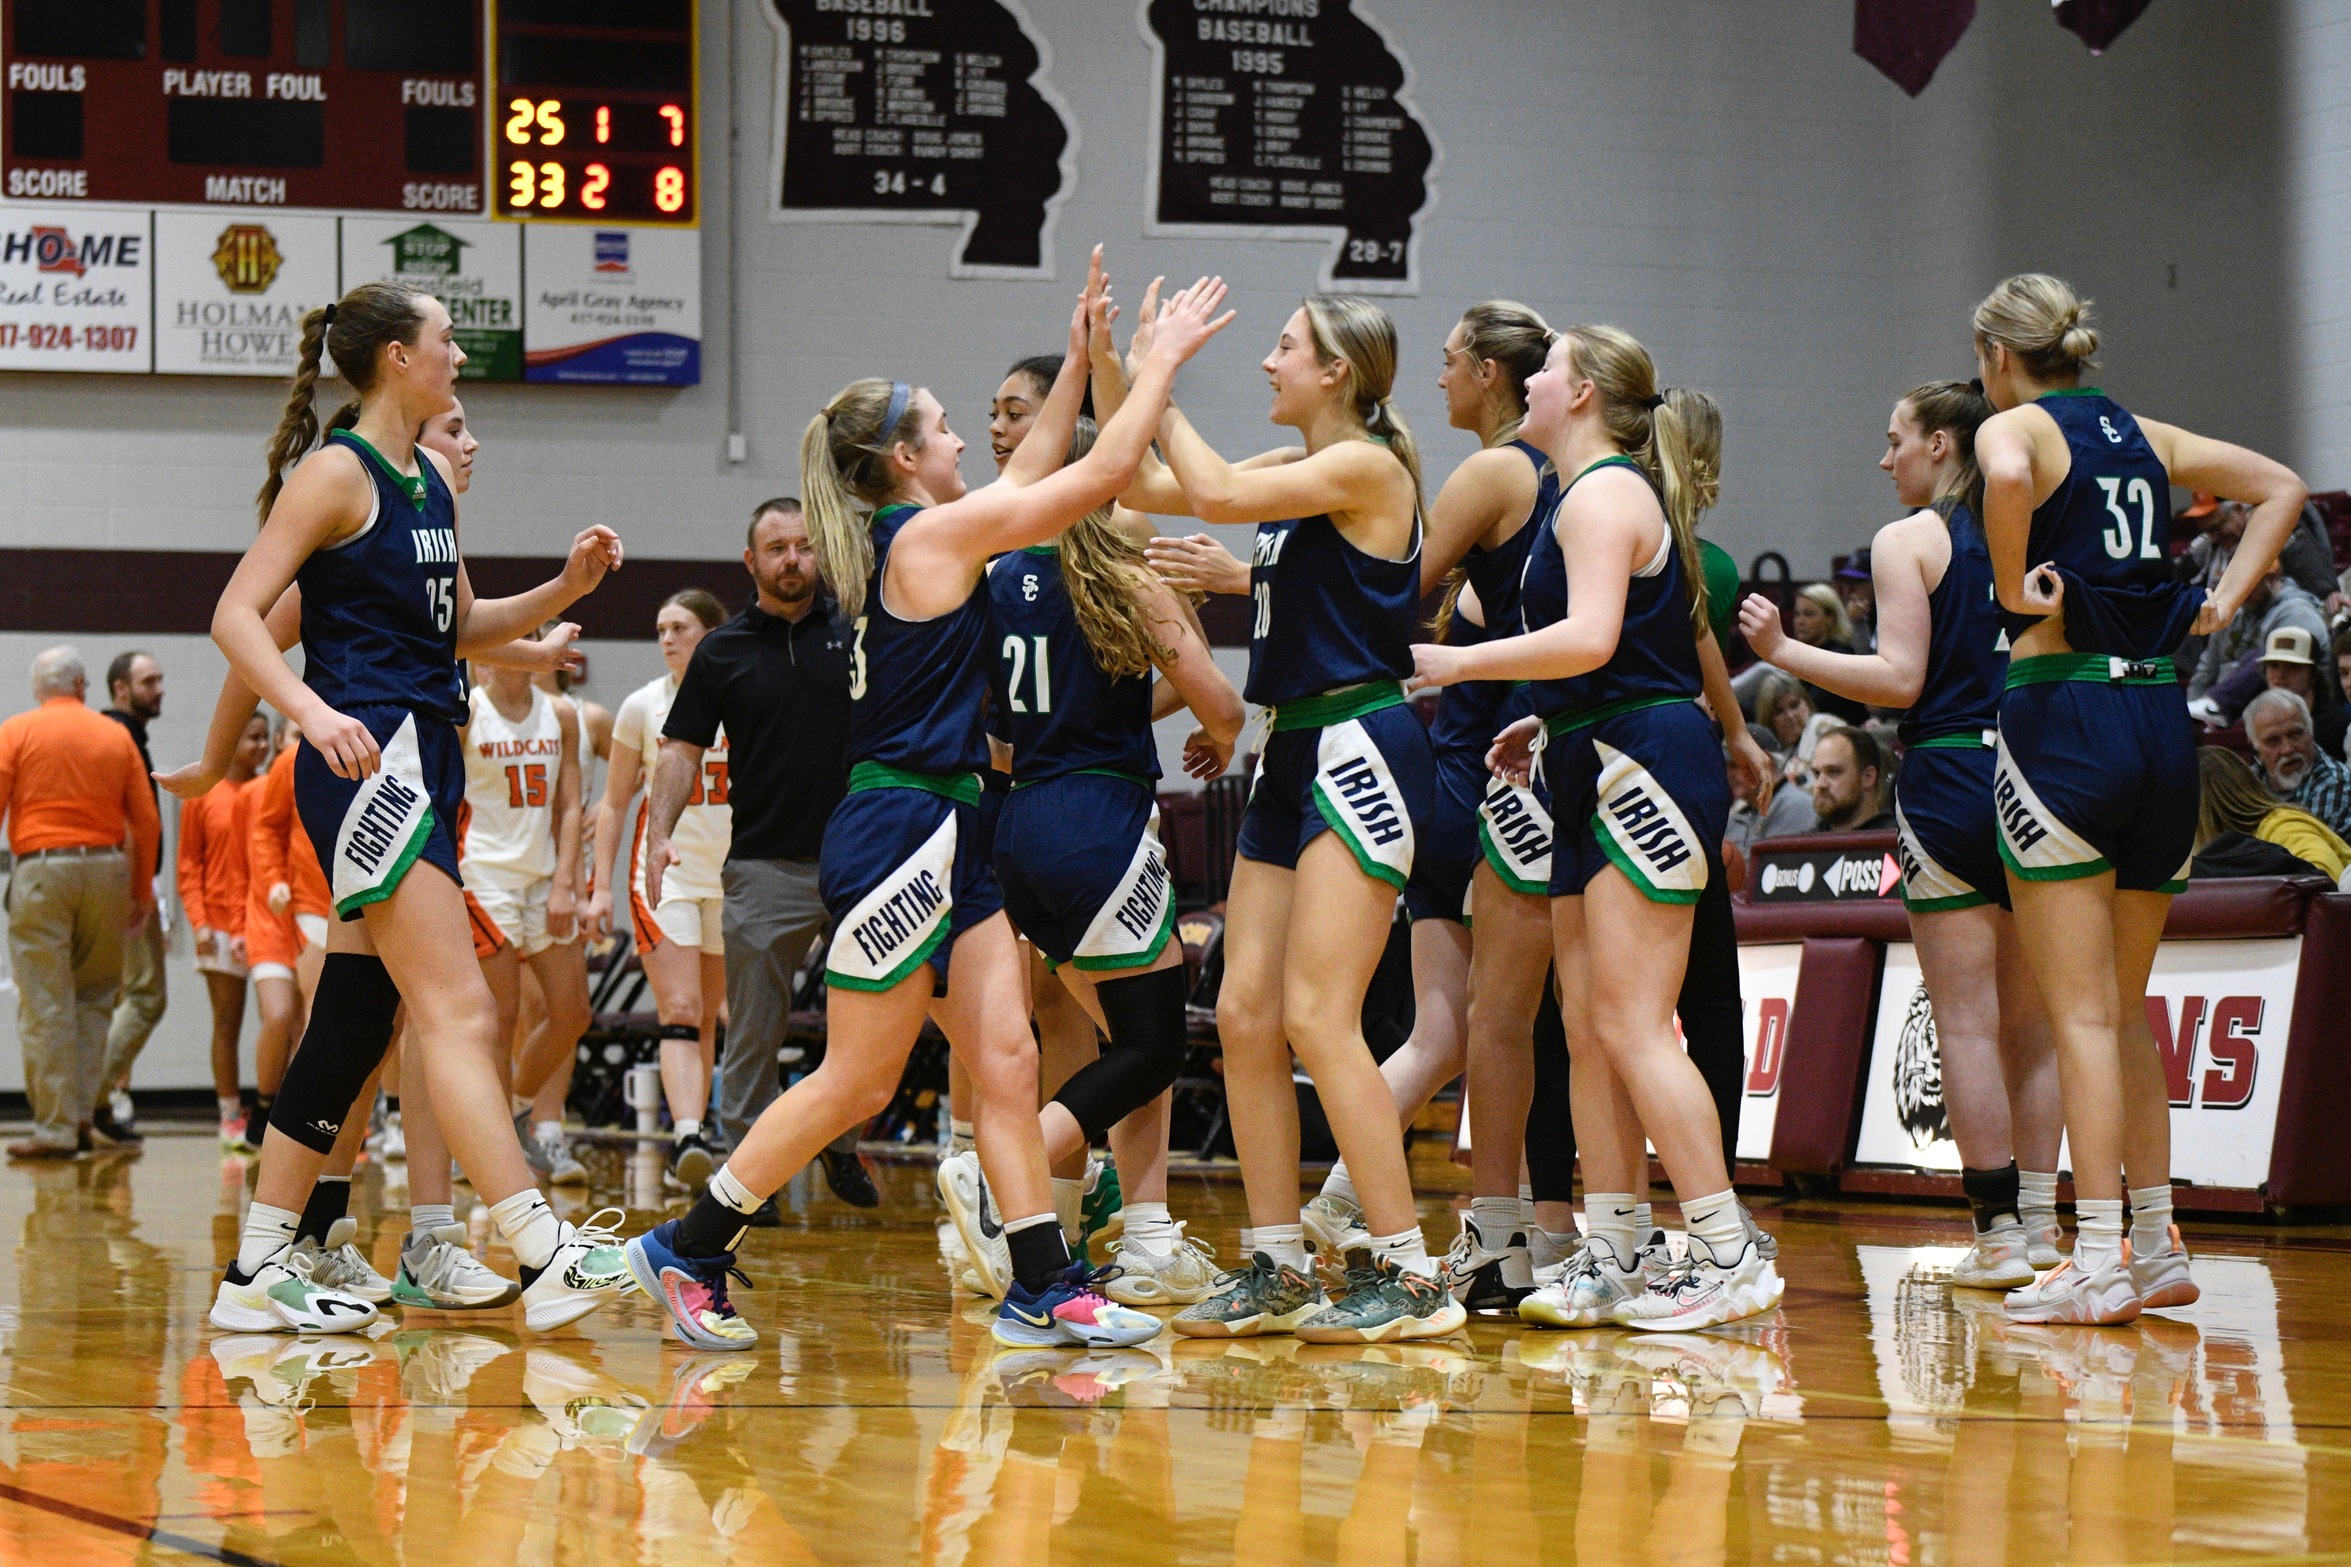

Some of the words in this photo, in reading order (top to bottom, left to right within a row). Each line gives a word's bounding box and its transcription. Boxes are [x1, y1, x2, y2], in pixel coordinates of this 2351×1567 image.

[1193, 0, 1320, 18] CHAMPIONS
[1197, 18, 1315, 47] BASEBALL
[9, 63, 86, 93] FOULS
[1232, 50, 1285, 74] 1995
[163, 70, 251, 98] PLAYER
[266, 74, 327, 101] FOUL
[402, 79, 476, 107] FOULS
[506, 99, 565, 145] 25
[596, 106, 609, 143] 1
[659, 105, 683, 146] 7
[8, 168, 87, 197] SCORE
[205, 175, 286, 203] MATCH
[402, 183, 478, 210] SCORE
[510, 161, 565, 208] 33
[581, 164, 609, 209] 2
[655, 166, 683, 212] 8
[0, 232, 142, 267] HO-ME
[55, 283, 127, 307] Estate
[201, 332, 295, 355] HOWE
[2095, 476, 2162, 560] 32
[1002, 634, 1051, 714] 21
[505, 764, 548, 808] 15
[1327, 756, 1403, 846] IRISH
[345, 774, 419, 876] FIGHTING
[1485, 784, 1552, 866] IRISH
[1994, 769, 2048, 852] IRISH
[1608, 786, 1691, 874] IRISH
[1775, 869, 1799, 887] BONUS
[1839, 859, 1883, 892] POSS
[852, 869, 945, 967] FIGHTING
[1742, 998, 1791, 1097] D
